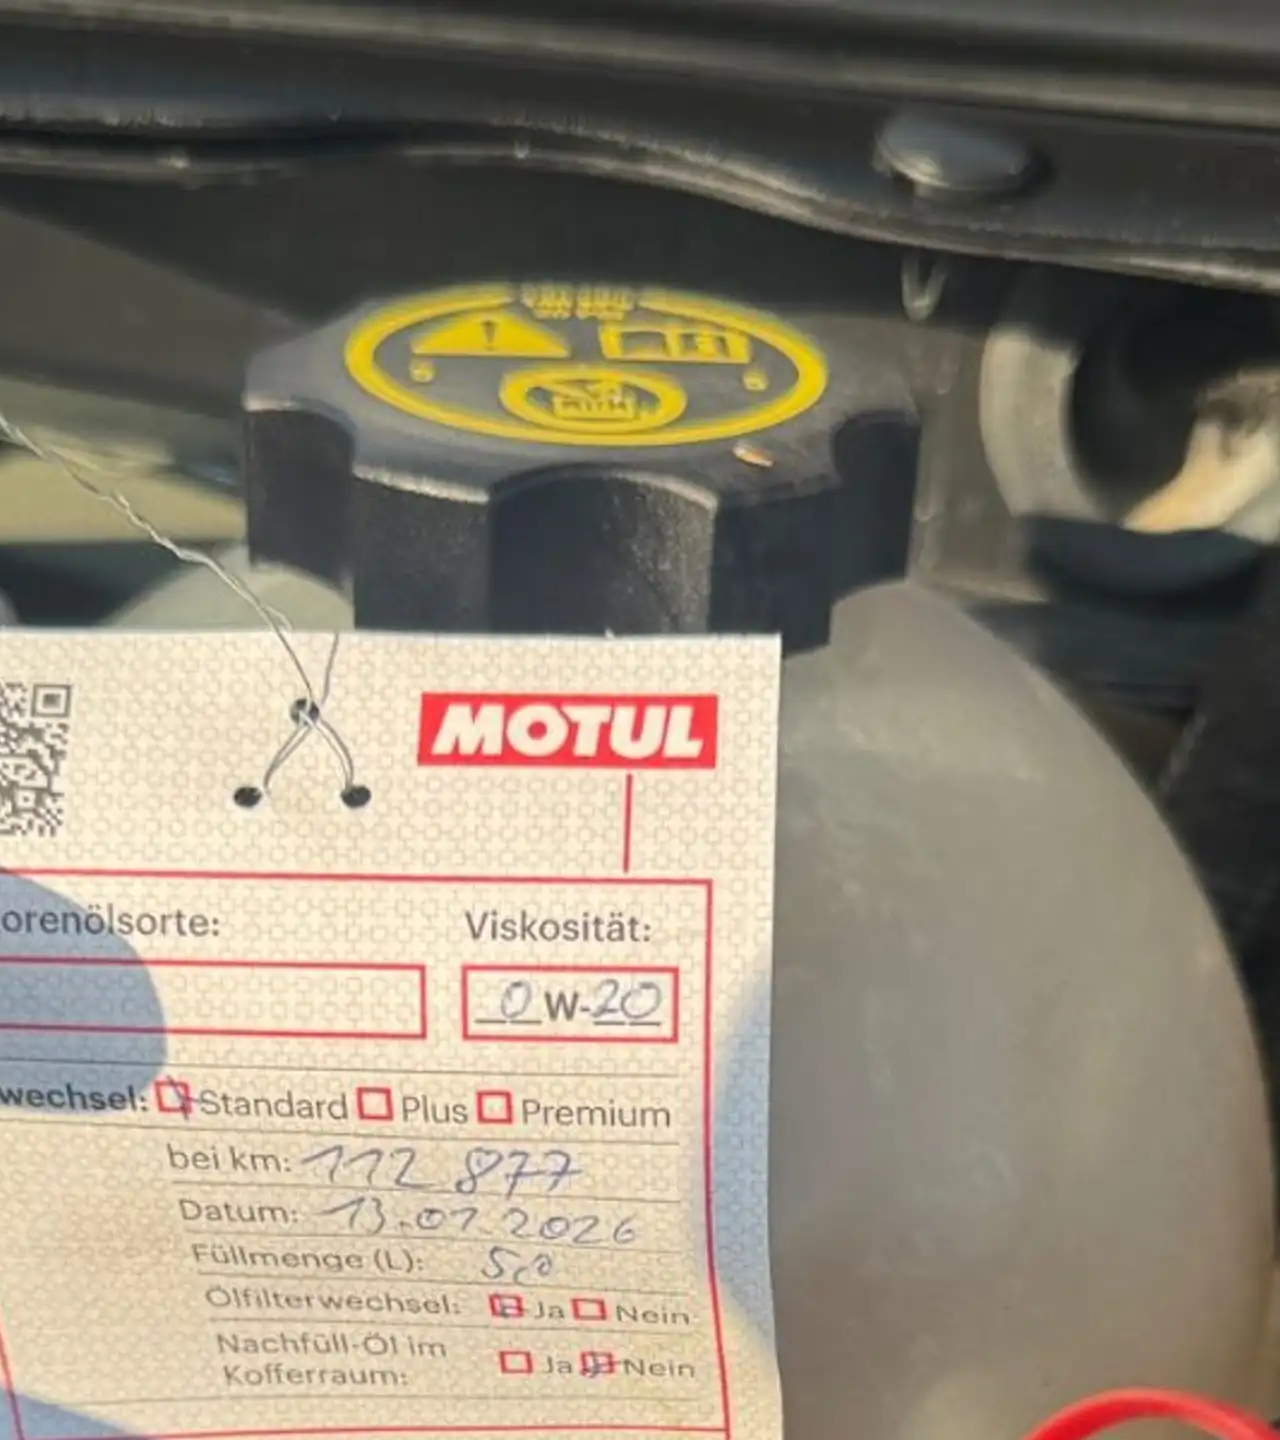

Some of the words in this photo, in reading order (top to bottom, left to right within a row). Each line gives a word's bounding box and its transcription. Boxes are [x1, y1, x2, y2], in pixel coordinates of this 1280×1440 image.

[431, 704, 705, 757] MOTUL
[464, 908, 652, 945] Viskosität:
[198, 1089, 349, 1123] Standard
[401, 1095, 469, 1126] Plus
[521, 1098, 672, 1129] Premium
[167, 1143, 222, 1172] bei
[230, 1146, 291, 1175] km:
[179, 1199, 299, 1224] Datum:
[192, 1244, 365, 1274] Füllmenge
[373, 1247, 424, 1273] (L):
[205, 1283, 461, 1316] Ölfilterwechsel:
[534, 1302, 565, 1320] Ja
[615, 1305, 690, 1326] Nein
[216, 1331, 400, 1358] Nachfüll-Öl
[406, 1338, 447, 1360] im
[542, 1357, 573, 1376] Ja
[622, 1361, 695, 1380] Nein
[224, 1364, 409, 1388] Kofferraum:
